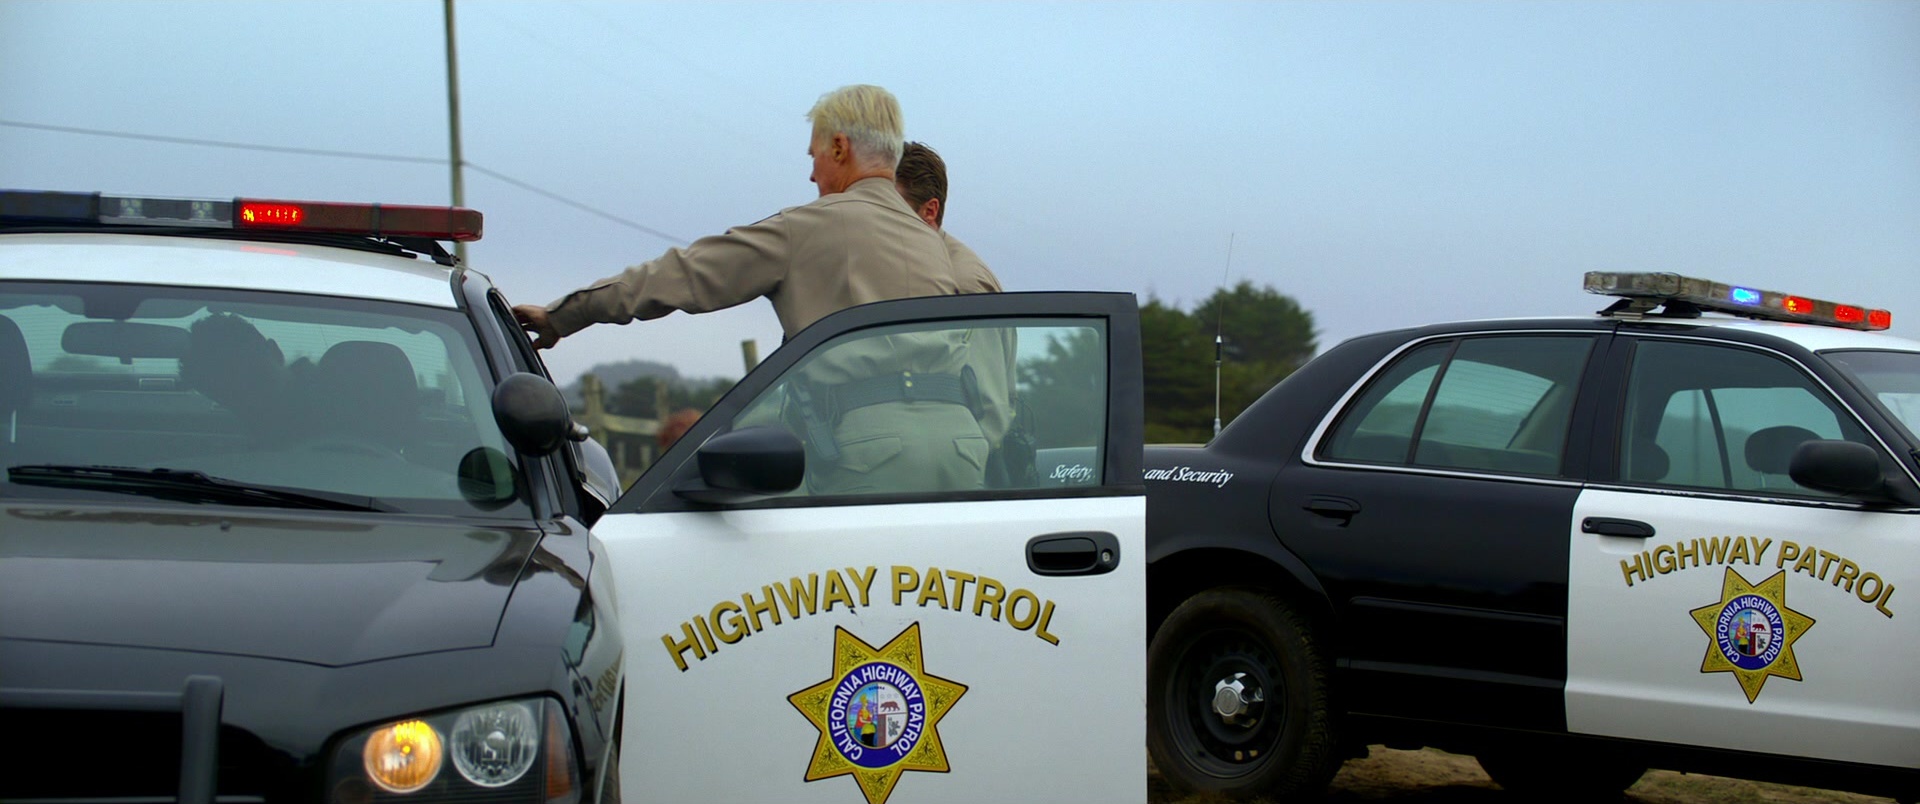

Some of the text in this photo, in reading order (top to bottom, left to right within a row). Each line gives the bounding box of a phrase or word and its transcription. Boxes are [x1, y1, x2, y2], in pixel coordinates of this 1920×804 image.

[1049, 464, 1234, 488] Safety, and Security
[1620, 536, 1896, 618] HIGHWAY PATROL
[661, 565, 1060, 672] HIGHWAY PATROL
[1718, 597, 1782, 664] CALIFORNIA HIGHWAY PATROL
[831, 665, 923, 760] CALIFORNIA HIGHWAY PATROL
